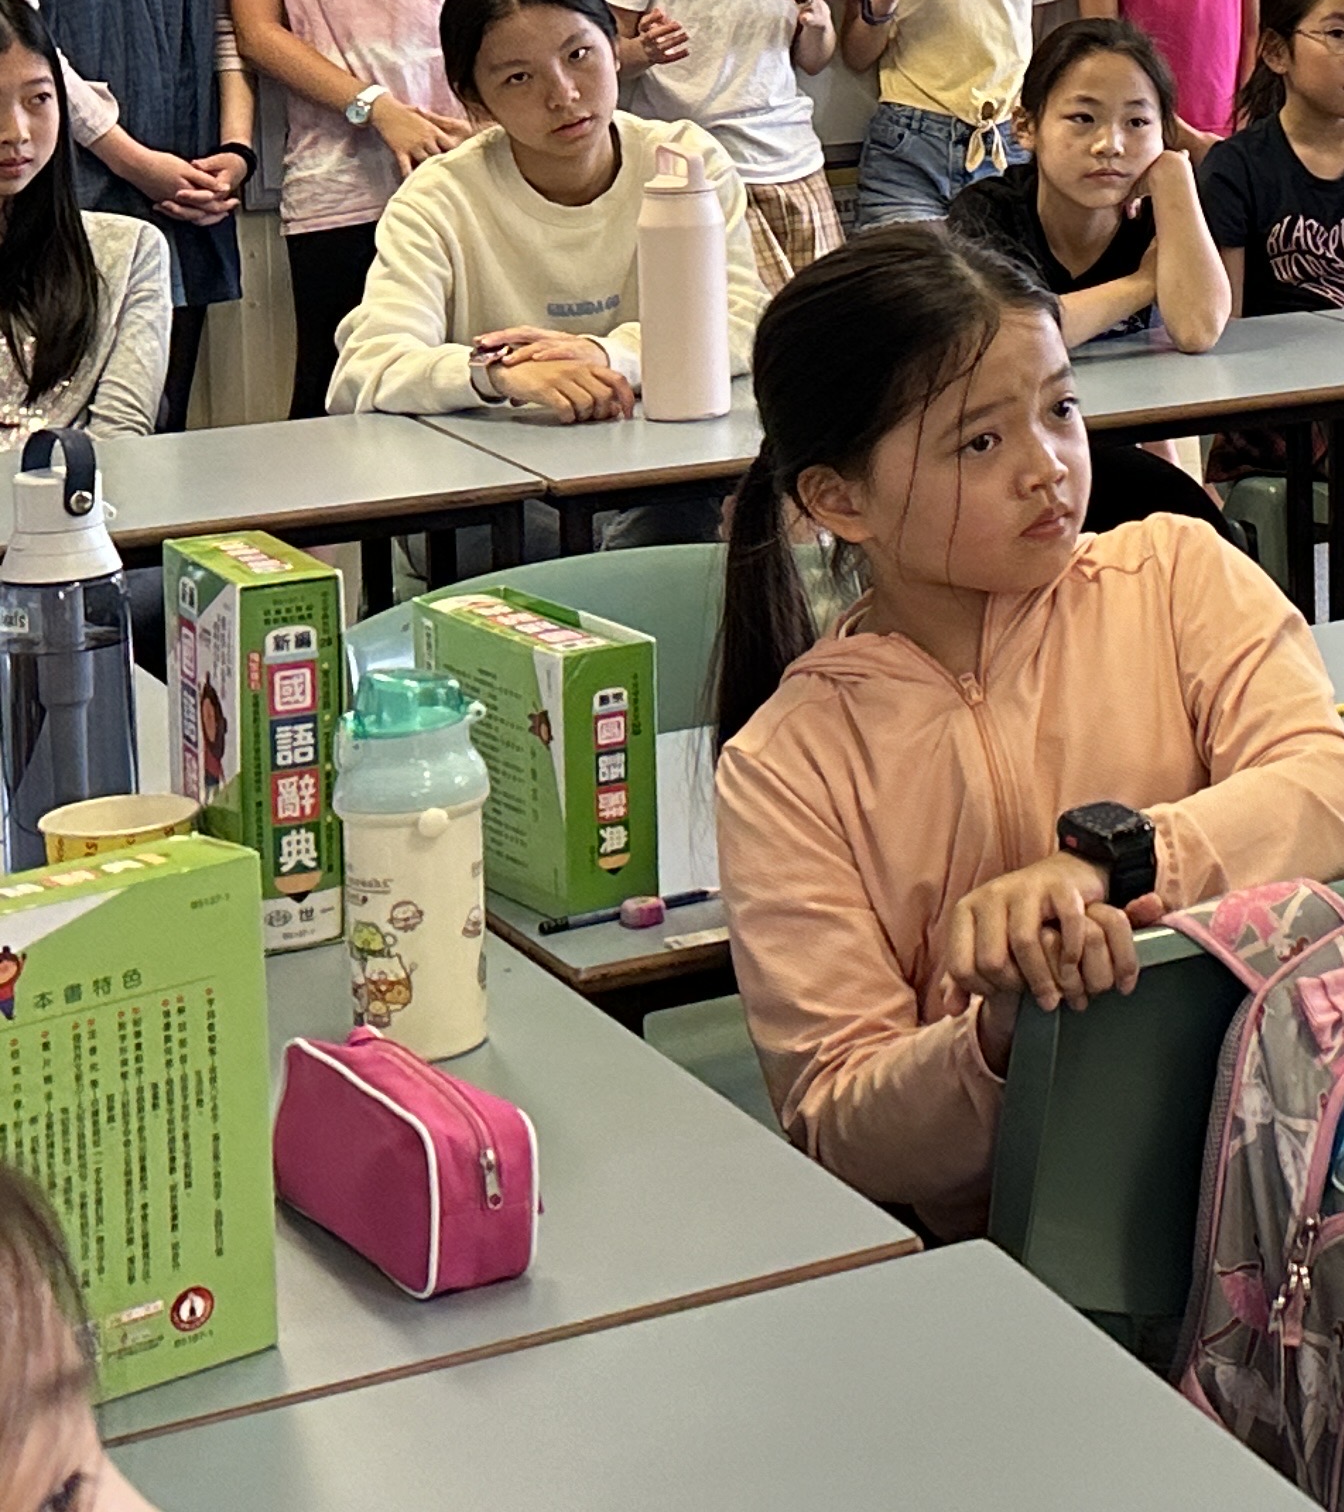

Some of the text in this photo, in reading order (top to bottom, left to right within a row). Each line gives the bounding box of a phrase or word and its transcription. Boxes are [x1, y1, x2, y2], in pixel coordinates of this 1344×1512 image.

[274, 667, 318, 873] 國語辭典
[33, 967, 143, 1011] 本書特色
